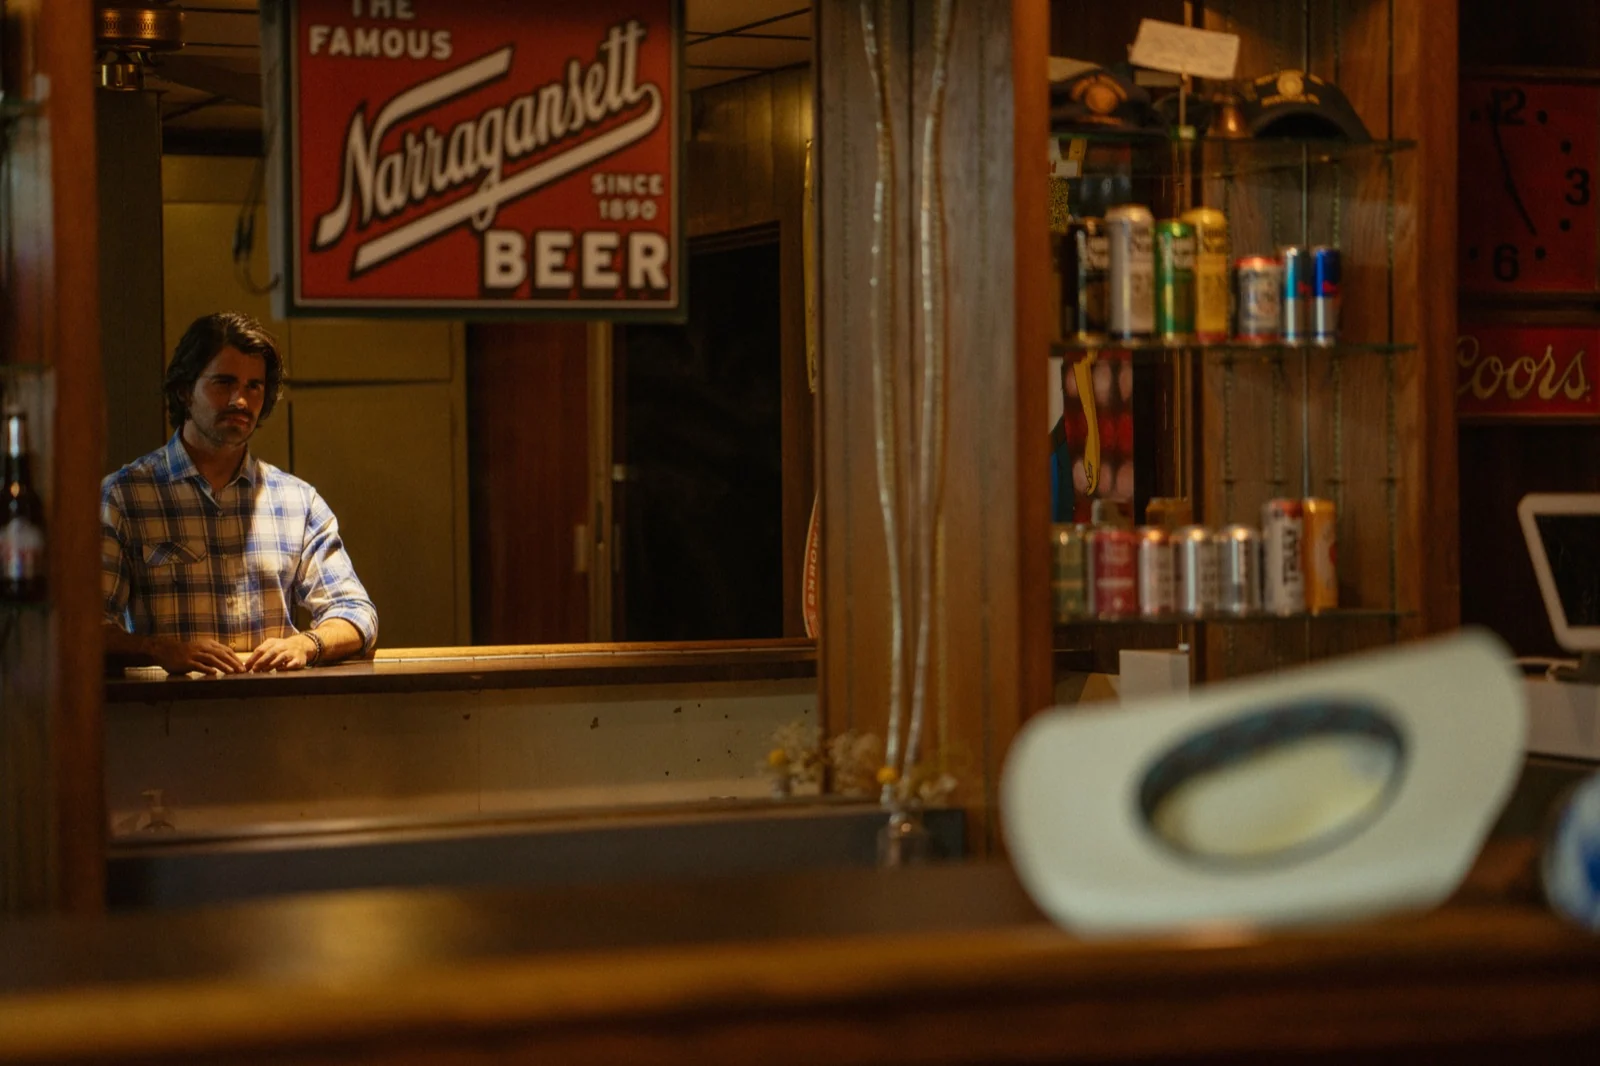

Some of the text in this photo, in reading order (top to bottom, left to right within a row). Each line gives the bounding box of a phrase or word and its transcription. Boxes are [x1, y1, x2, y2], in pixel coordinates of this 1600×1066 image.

[309, 25, 452, 59] FAMOUS
[316, 20, 661, 248] Narragansett
[592, 173, 663, 195] SINCE
[1565, 168, 1590, 206] 3
[599, 201, 657, 220] 1890
[484, 231, 669, 289] BEER
[1493, 243, 1519, 282] 6
